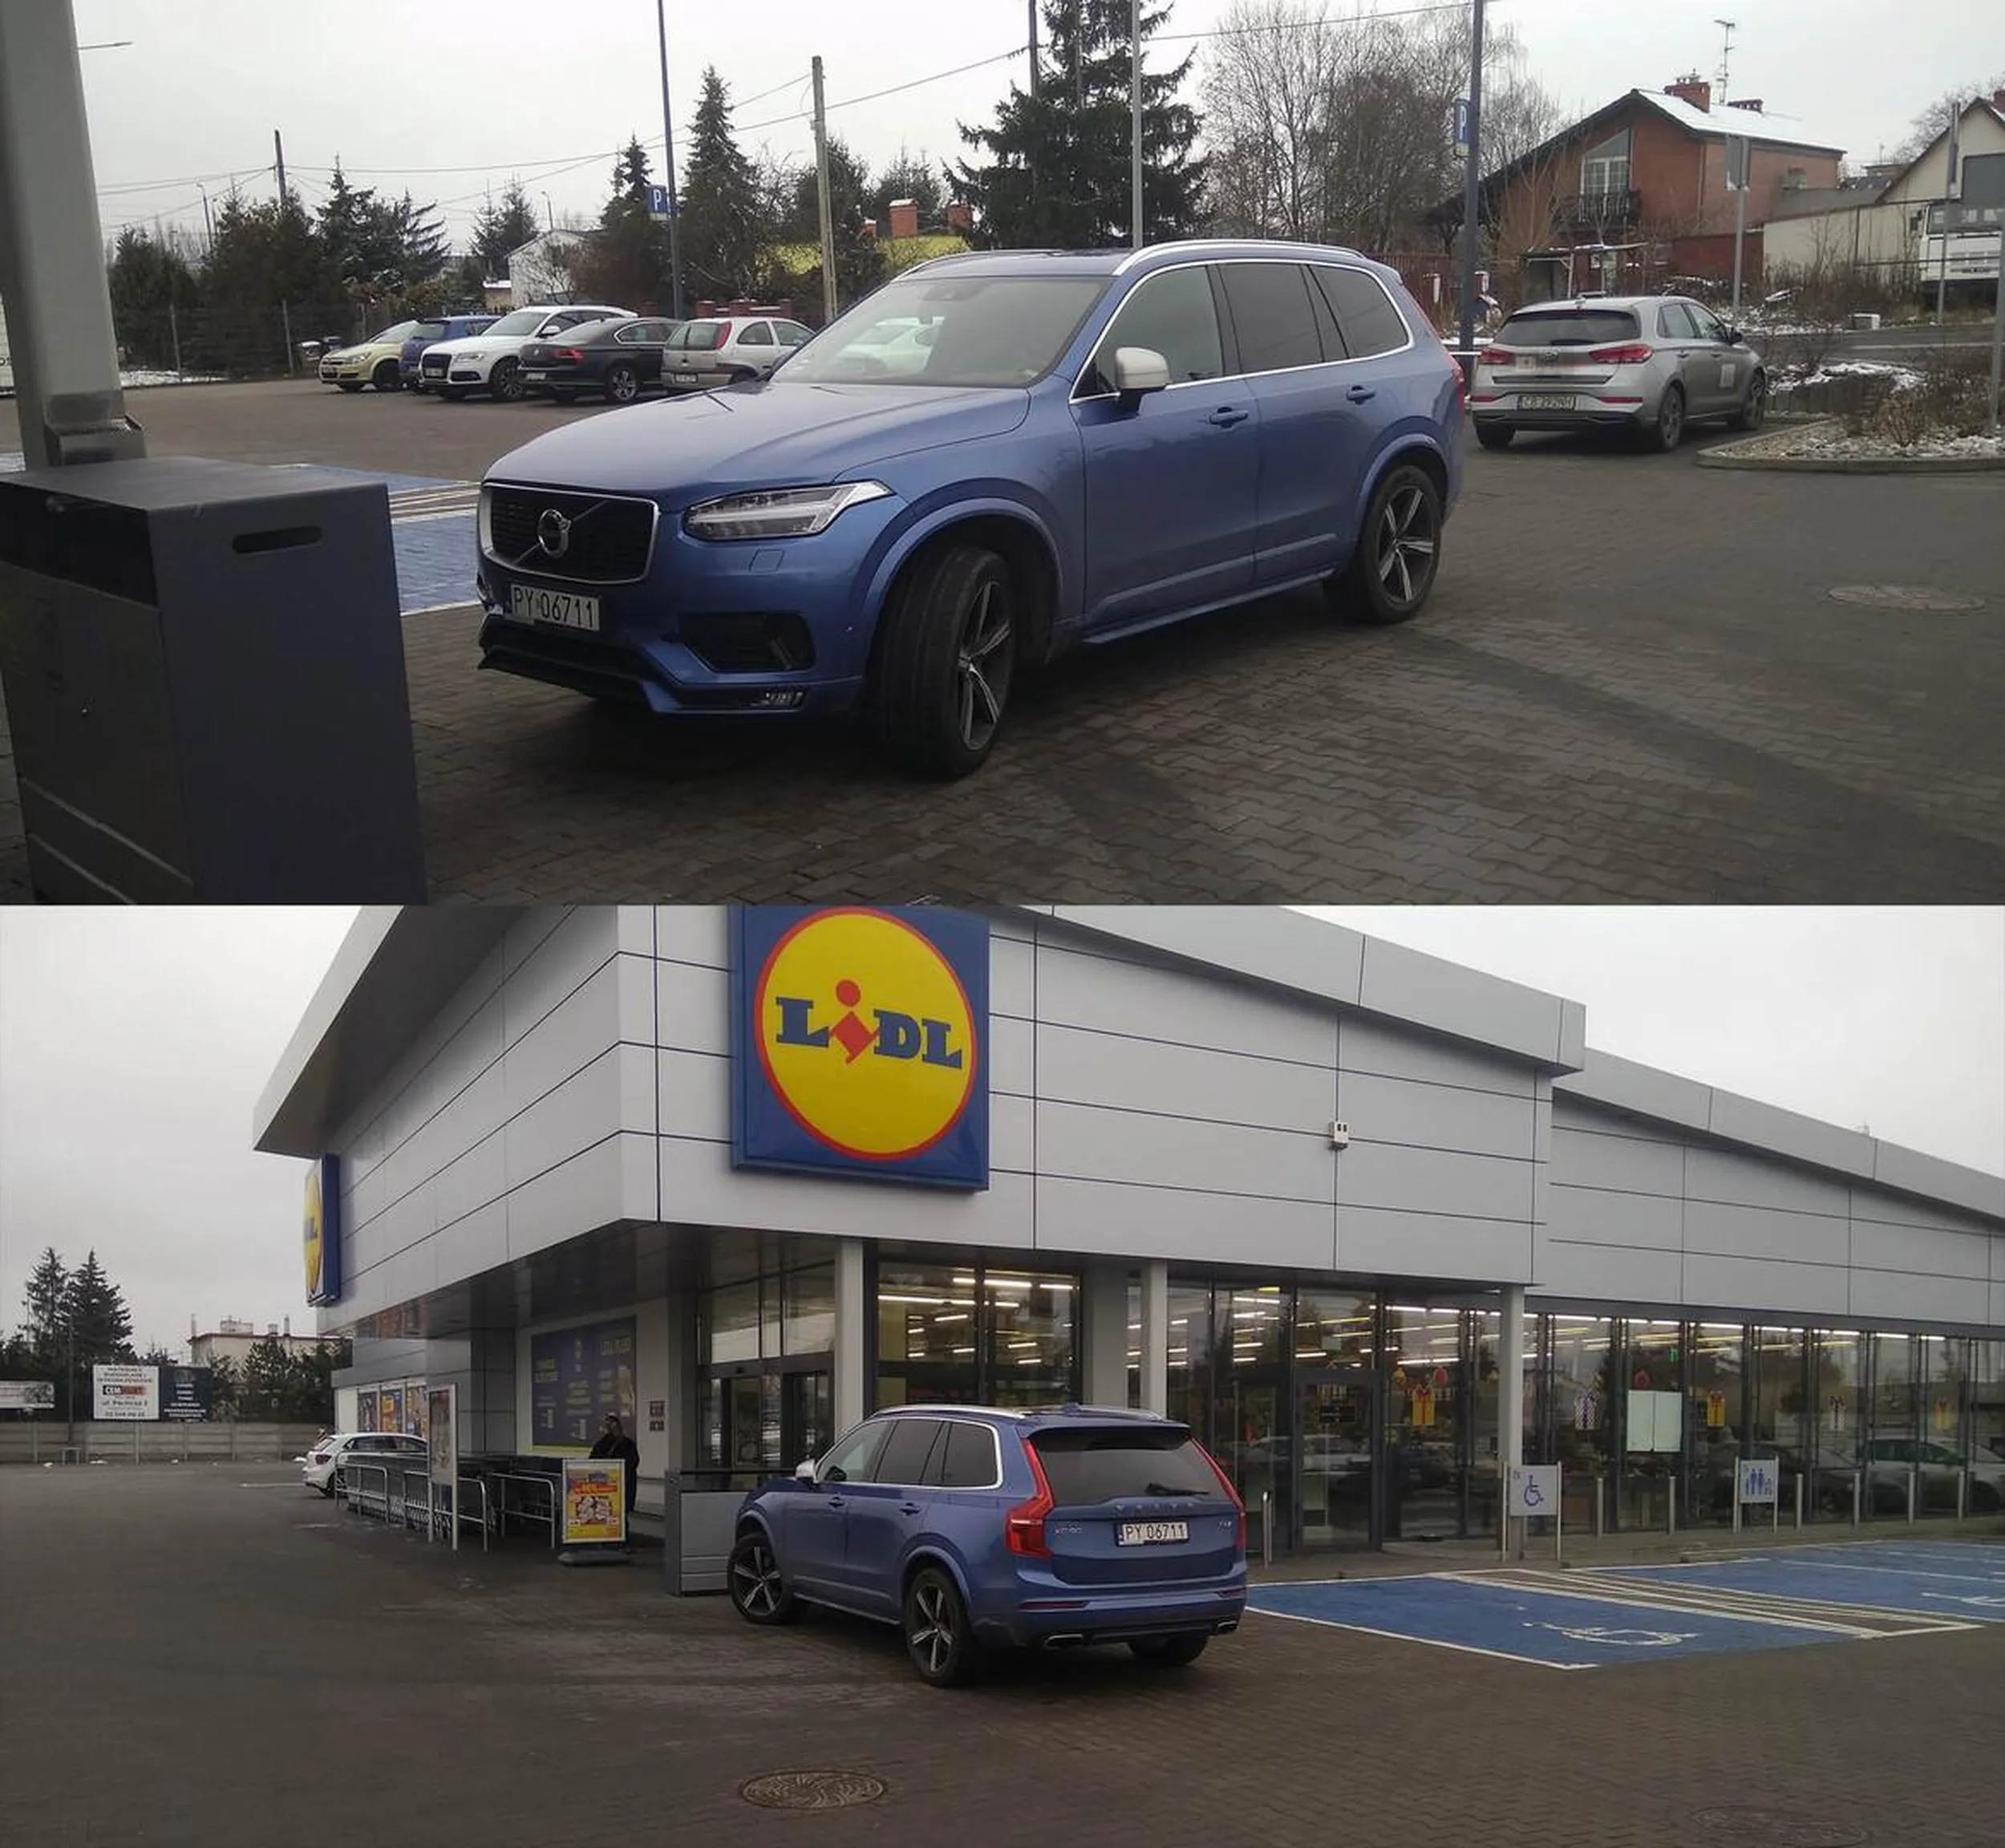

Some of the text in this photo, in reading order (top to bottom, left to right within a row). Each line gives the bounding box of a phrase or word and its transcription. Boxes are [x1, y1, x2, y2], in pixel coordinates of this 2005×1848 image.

[1459, 105, 1467, 140] P
[652, 188, 662, 211] P
[513, 586, 593, 628] PY 06711
[1125, 1523, 1185, 1540] PY 06711
